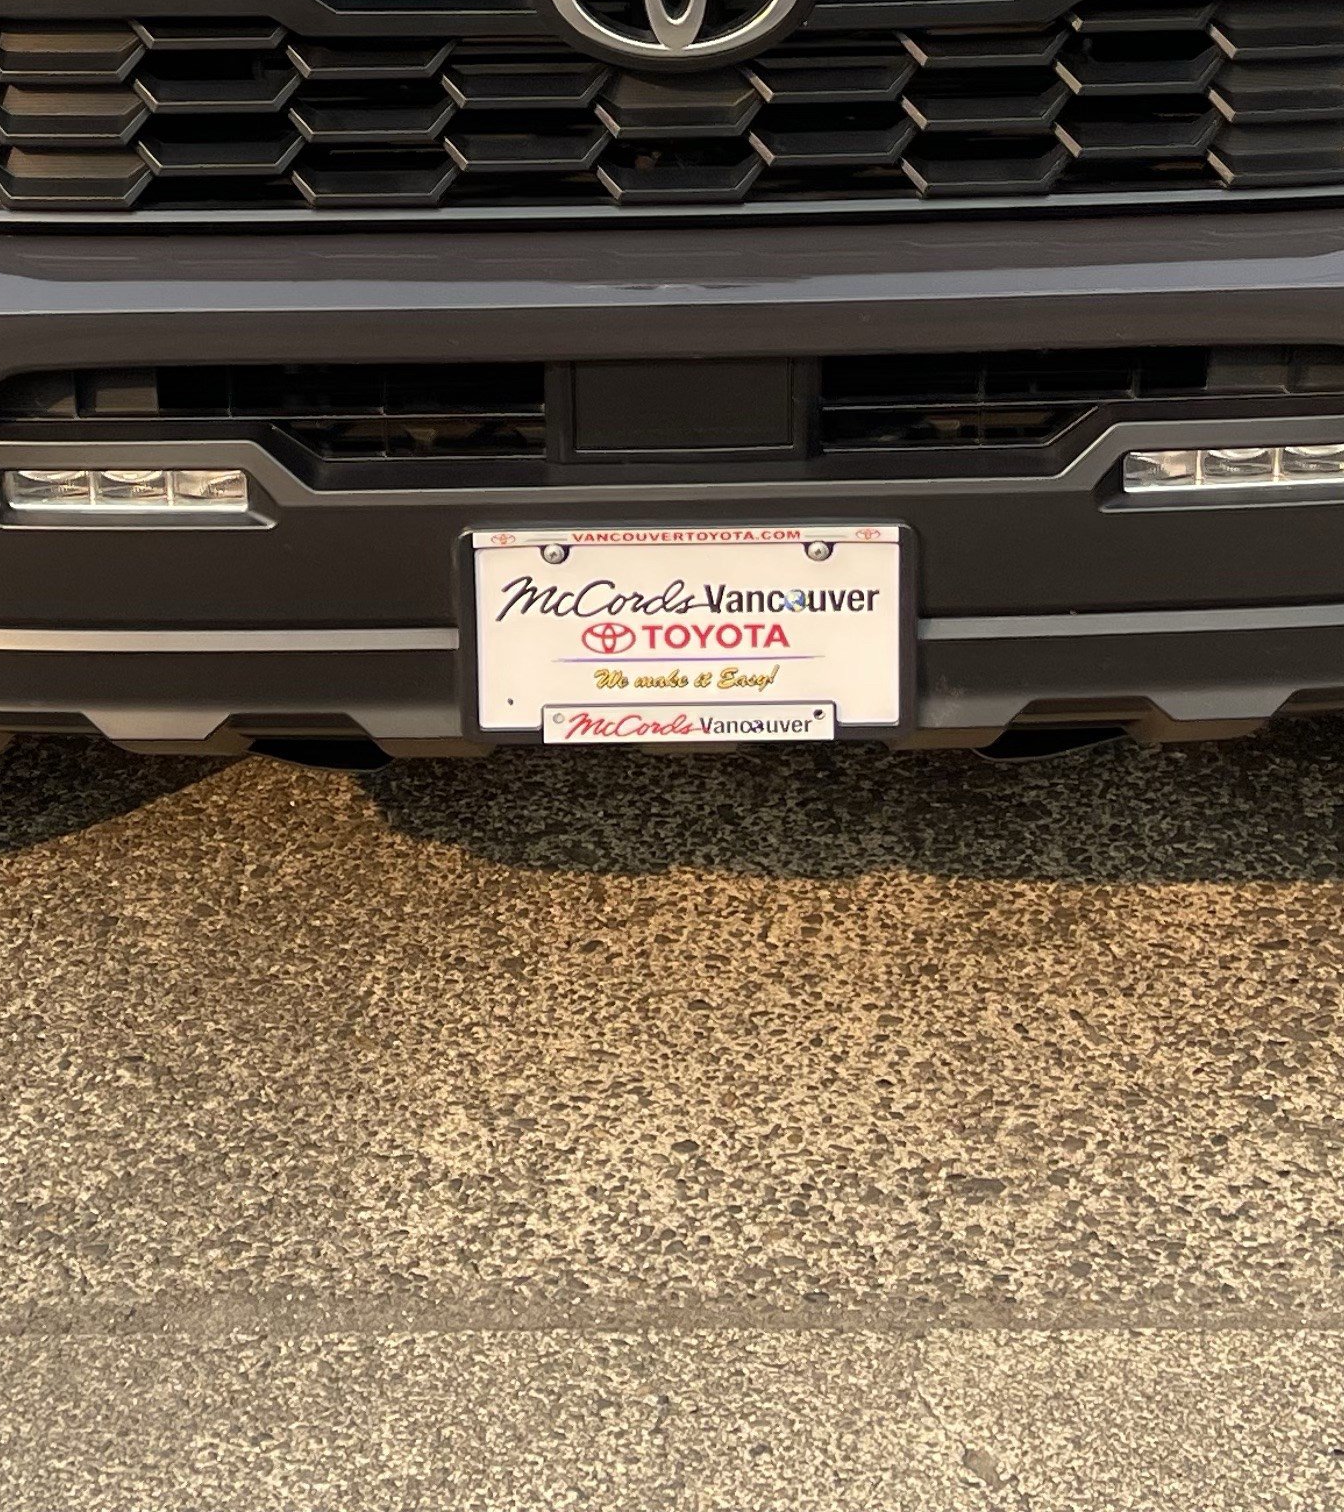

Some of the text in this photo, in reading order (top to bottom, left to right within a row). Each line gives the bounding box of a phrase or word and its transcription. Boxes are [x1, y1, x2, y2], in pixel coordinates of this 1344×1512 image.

[571, 530, 801, 543] VANCOUVERTOYOTA.COM
[495, 575, 697, 622] McCords
[641, 623, 791, 649] TOYOTA
[594, 664, 780, 692] We make it Easy!
[565, 712, 694, 739] McCords
